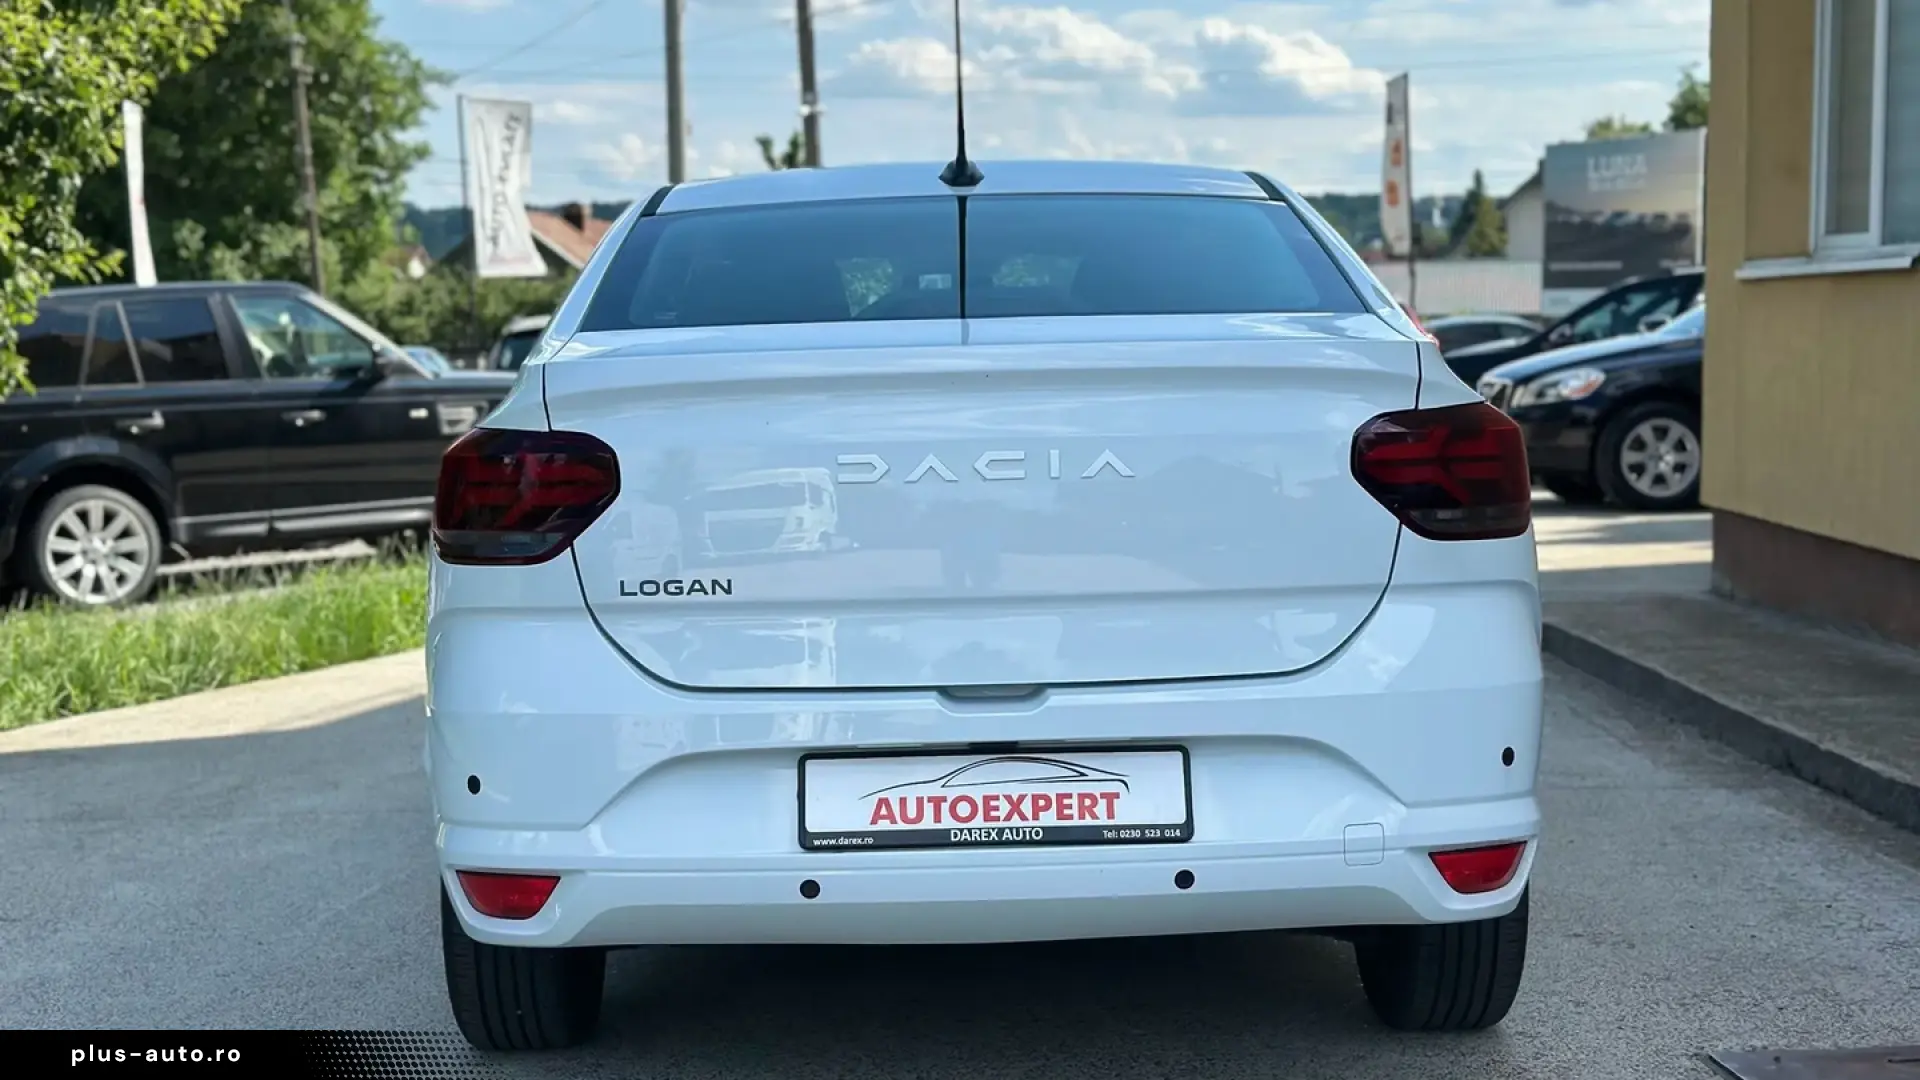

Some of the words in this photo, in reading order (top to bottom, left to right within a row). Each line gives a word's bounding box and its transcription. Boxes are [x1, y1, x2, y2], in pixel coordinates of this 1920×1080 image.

[836, 448, 1136, 484] DACIA
[618, 578, 733, 597] LOGAN
[869, 791, 1121, 826] AUTOEXPERT
[812, 836, 874, 846] www.darex.ro
[950, 828, 998, 842] DAREX
[1002, 827, 1044, 841] AUTO
[1102, 829, 1119, 839] Tel:
[1119, 828, 1141, 839] 0230
[1144, 828, 1161, 838] 523
[1164, 828, 1181, 838] 014
